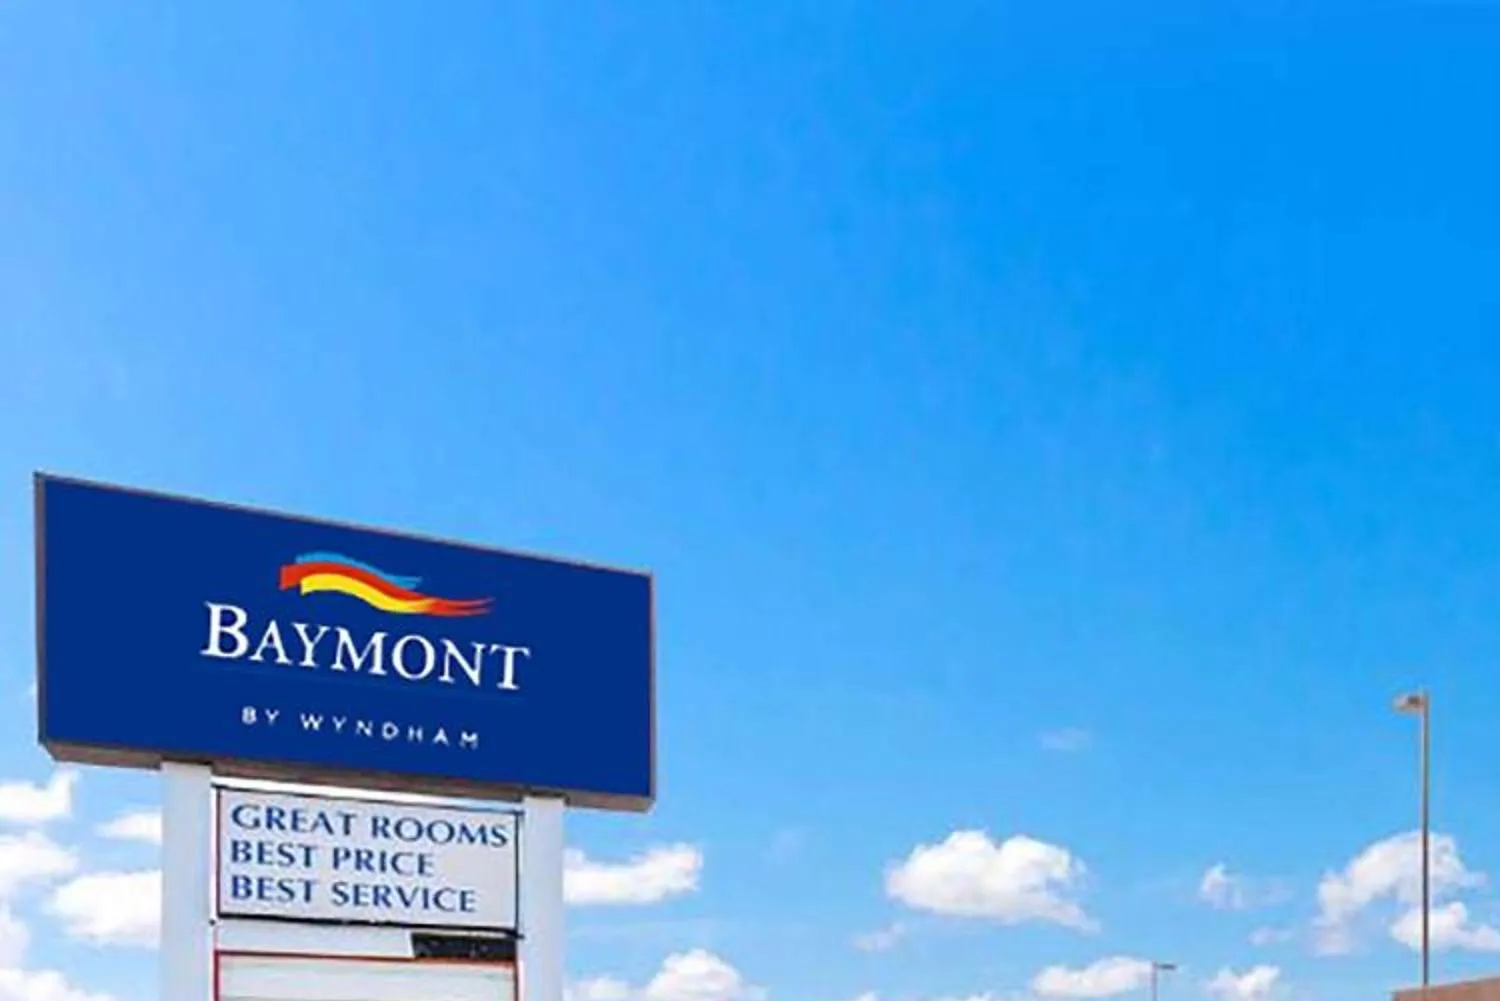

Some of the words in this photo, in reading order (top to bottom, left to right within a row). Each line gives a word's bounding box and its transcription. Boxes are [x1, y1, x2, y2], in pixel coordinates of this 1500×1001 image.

[200, 601, 531, 690] BAYMONT
[241, 706, 280, 726] BY
[300, 713, 479, 750] WYNDHAM
[231, 803, 357, 836] GREAT
[371, 815, 509, 848] ROOMS
[231, 839, 318, 868] BEST
[332, 846, 435, 877] PRICE
[231, 875, 318, 904] BEST
[331, 881, 477, 912] SERVICE
